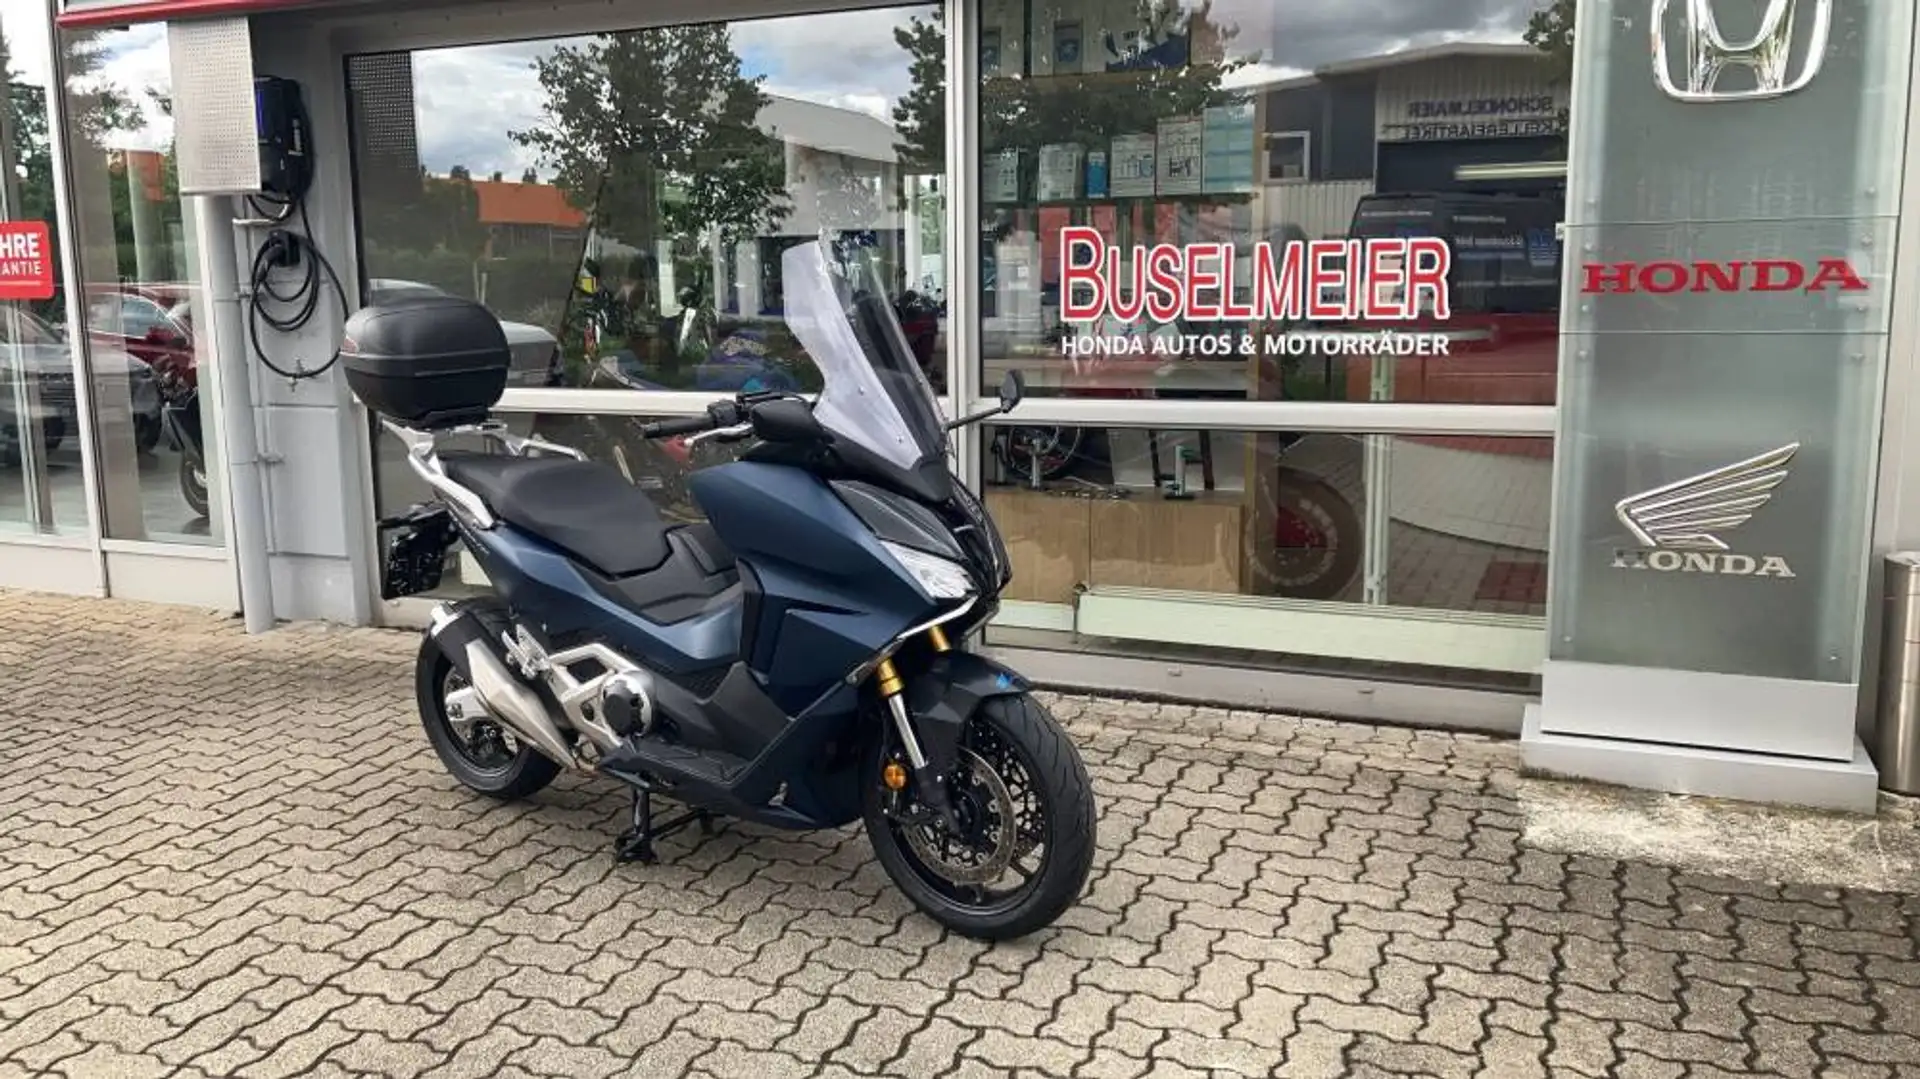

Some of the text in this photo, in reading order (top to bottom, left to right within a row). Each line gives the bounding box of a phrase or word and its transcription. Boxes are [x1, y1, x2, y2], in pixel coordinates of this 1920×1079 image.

[1580, 258, 1869, 293] HONDA
[1061, 329, 1450, 355] HONDA AUTOS & MOTORRÄDER
[1611, 548, 1797, 578] HONDA
